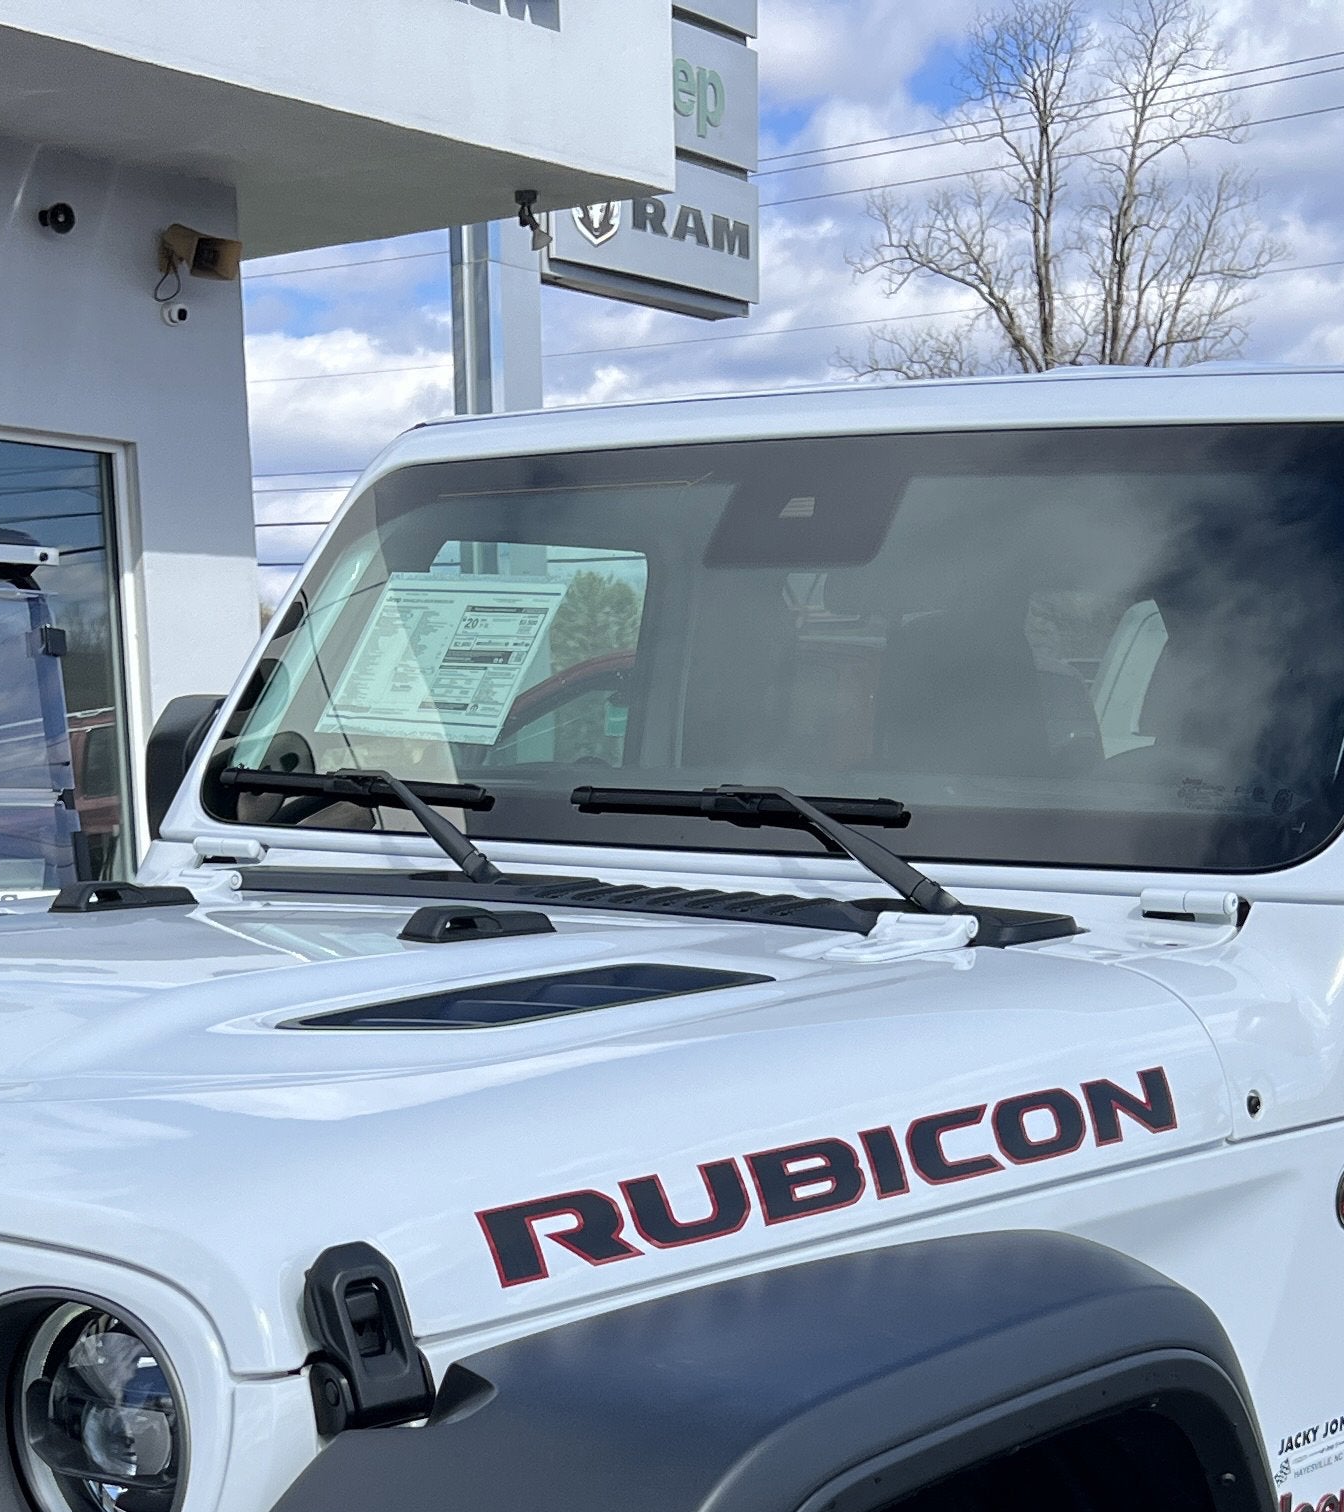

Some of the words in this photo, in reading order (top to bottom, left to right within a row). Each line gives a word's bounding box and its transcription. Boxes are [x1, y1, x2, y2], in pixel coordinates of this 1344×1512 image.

[673, 57, 726, 138] ep
[631, 198, 751, 260] RAM
[475, 1066, 1178, 1288] RUBICON
[1278, 1425, 1320, 1456] JACKY
[1334, 1452, 1344, 1463] NC
